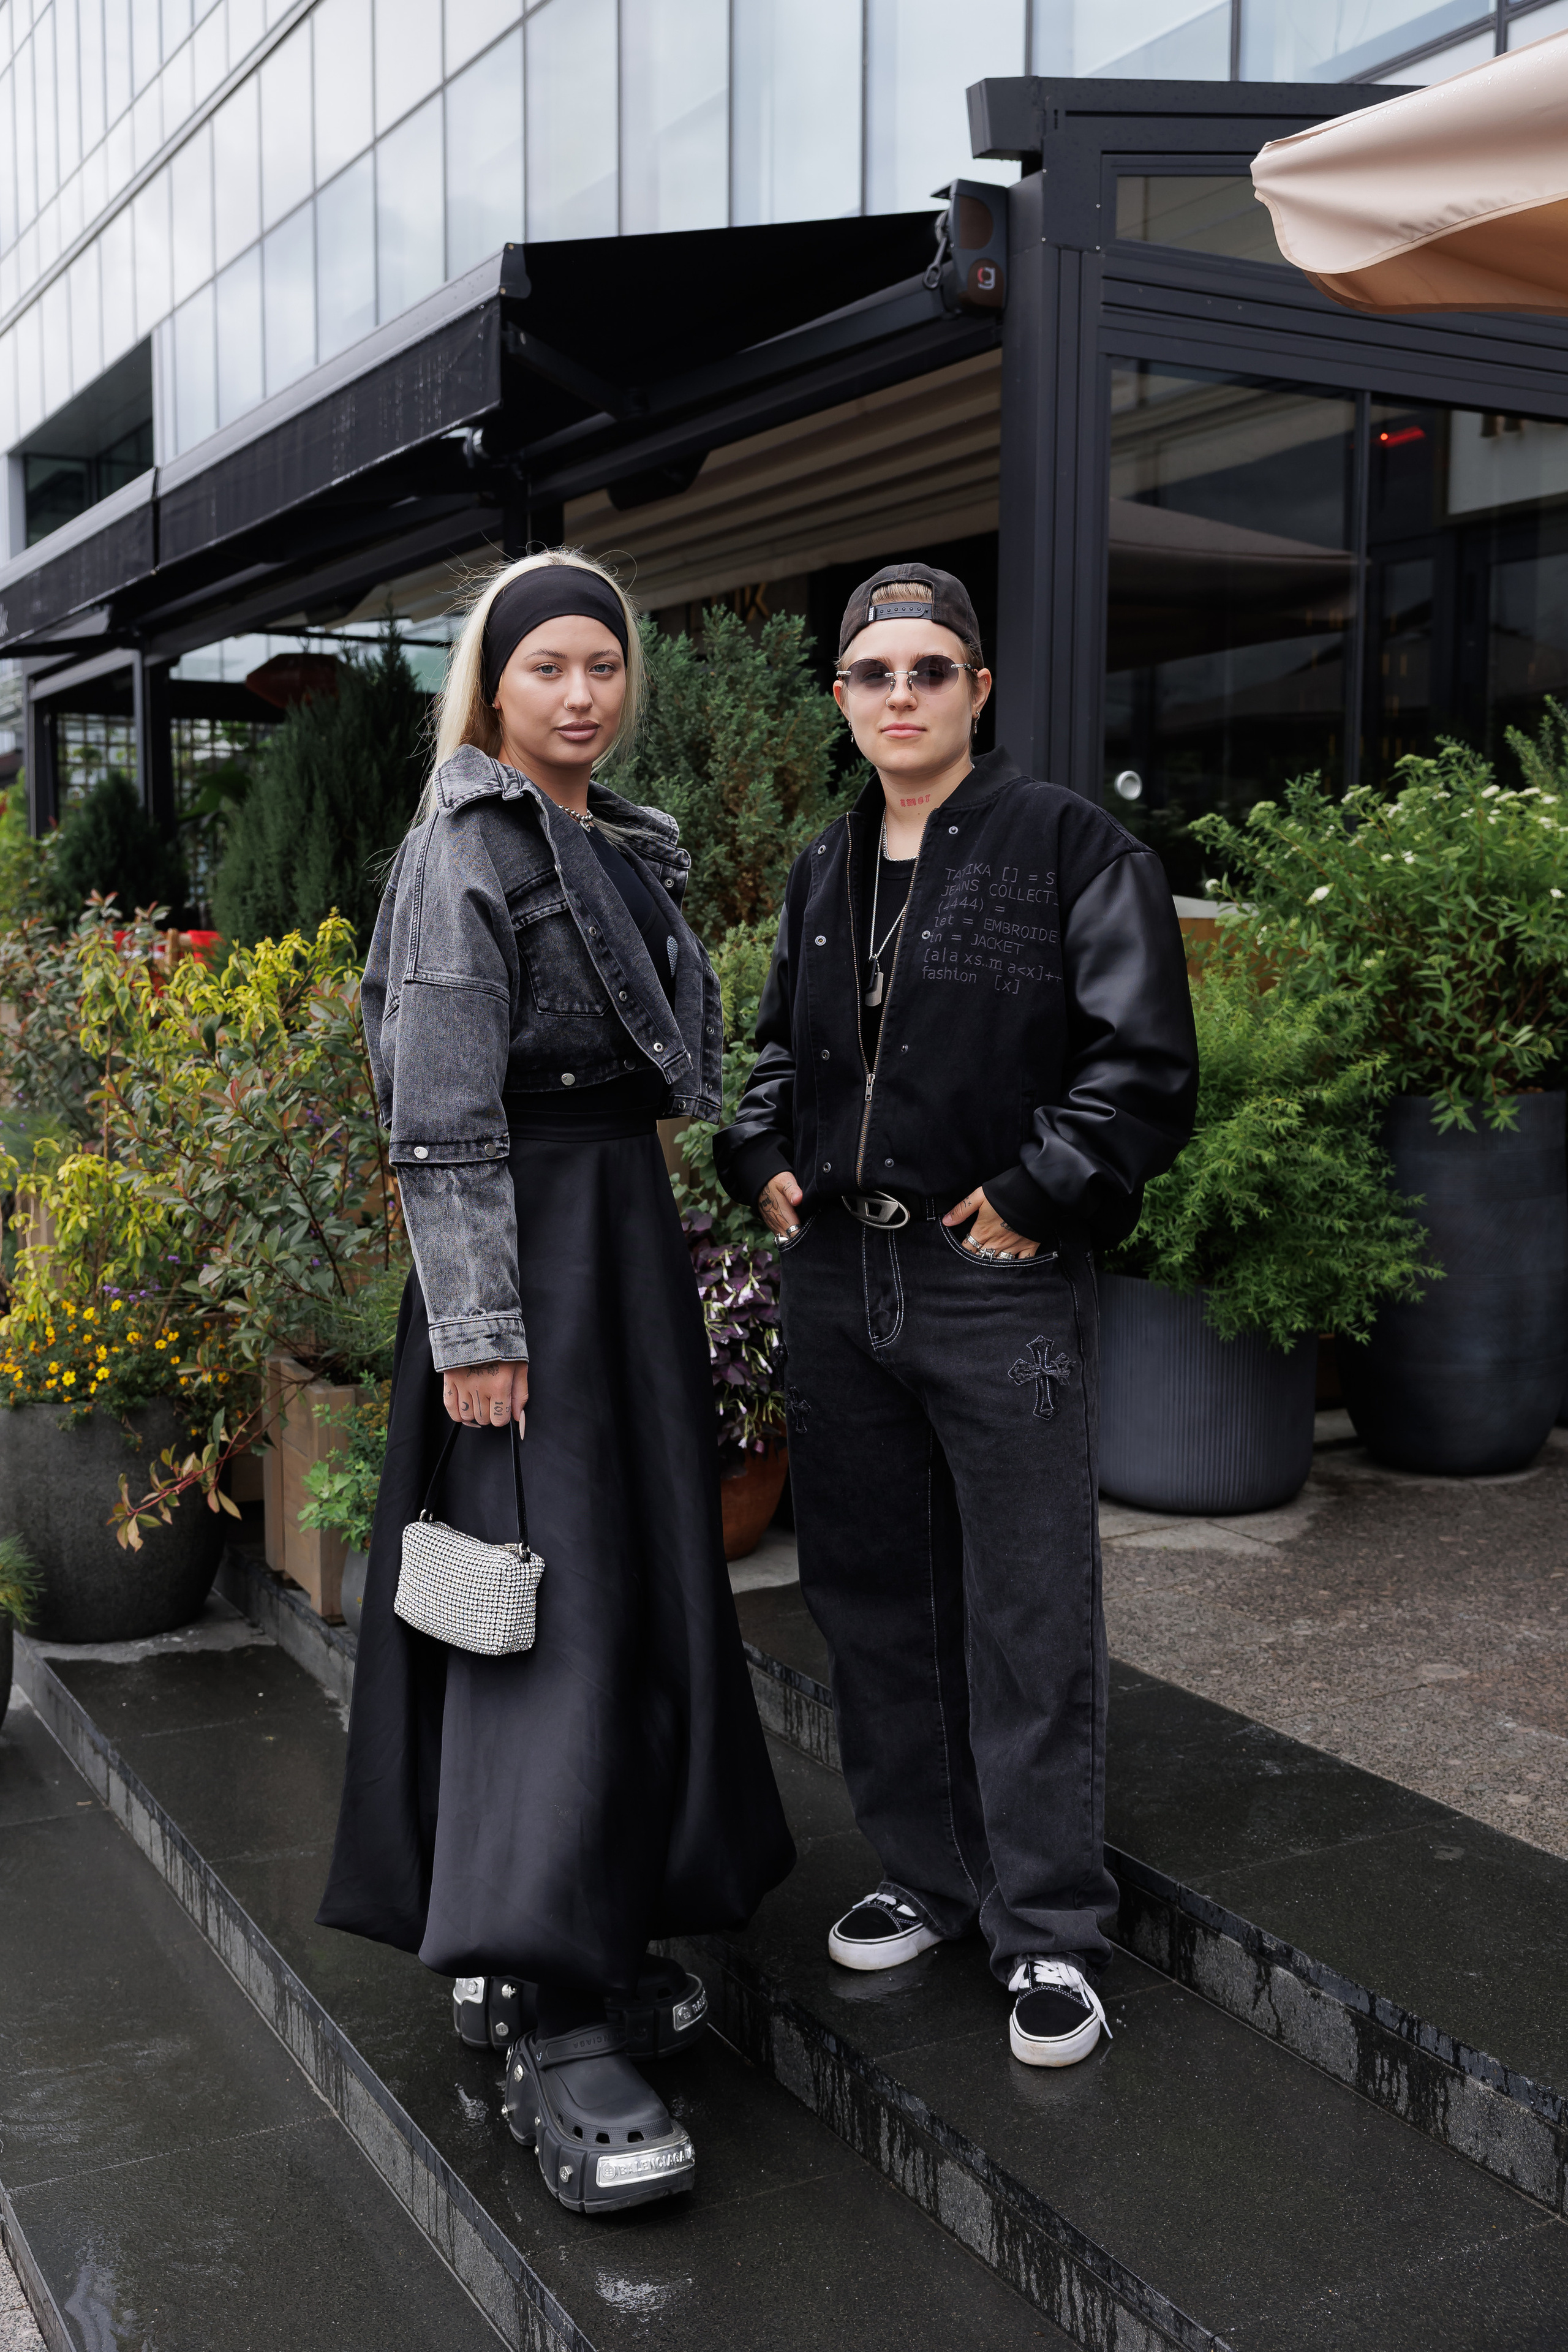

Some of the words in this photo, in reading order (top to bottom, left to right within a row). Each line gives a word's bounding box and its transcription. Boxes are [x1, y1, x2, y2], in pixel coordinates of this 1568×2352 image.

[900, 794, 931, 807] amor
[945, 862, 991, 881] TATIKA
[941, 880, 979, 897] JEANS
[971, 933, 1024, 955] JACKET
[922, 965, 977, 984] fashion
[619, 2150, 685, 2176] BALENCIAGA
